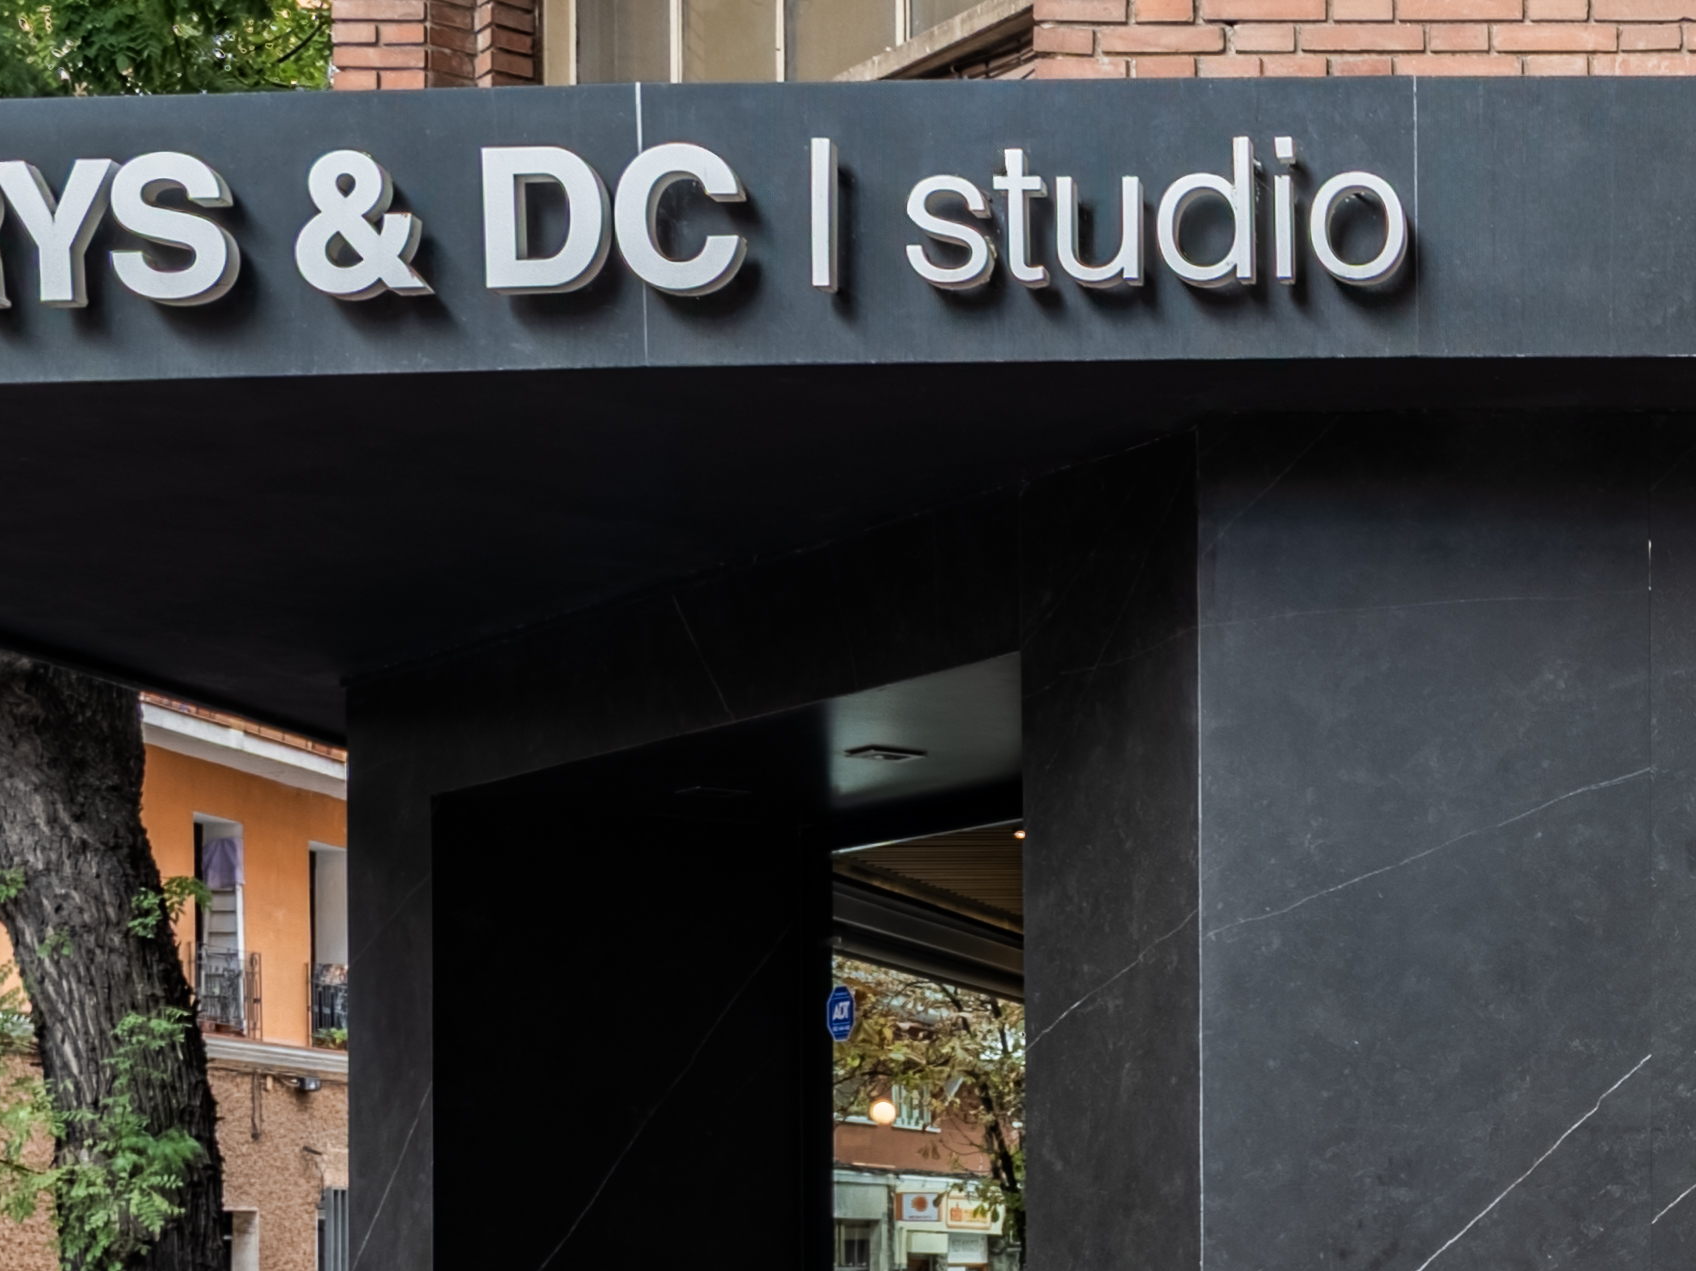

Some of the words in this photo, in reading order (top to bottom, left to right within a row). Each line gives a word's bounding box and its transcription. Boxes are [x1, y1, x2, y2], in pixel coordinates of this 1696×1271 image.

[293, 146, 433, 302] &
[481, 140, 746, 296] DC
[904, 133, 1411, 294] studio
